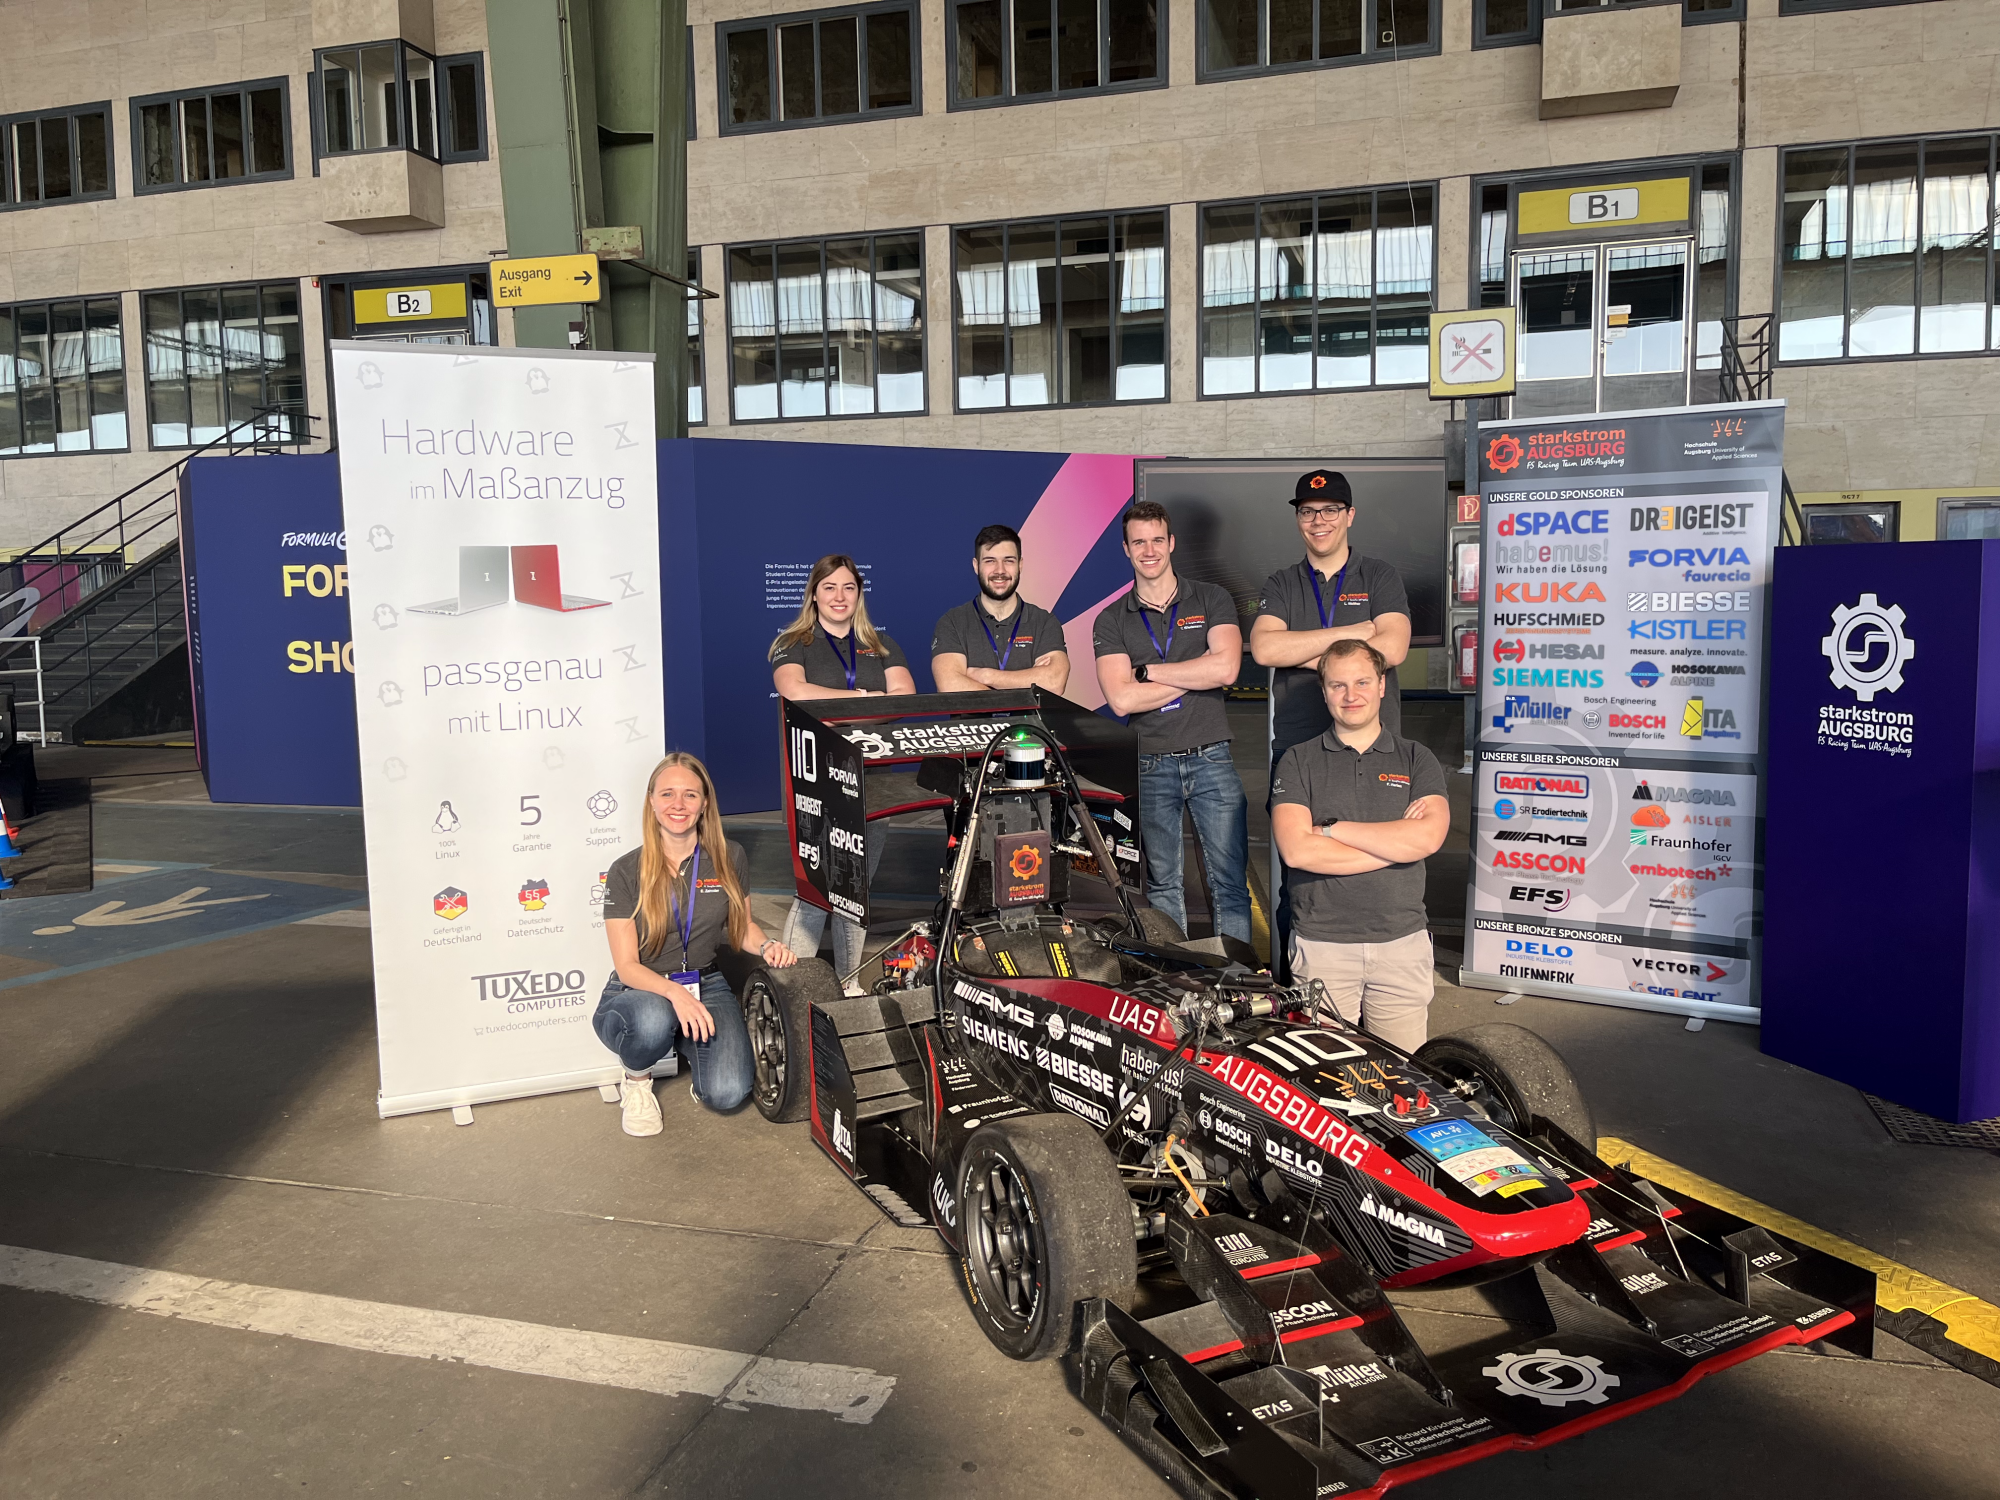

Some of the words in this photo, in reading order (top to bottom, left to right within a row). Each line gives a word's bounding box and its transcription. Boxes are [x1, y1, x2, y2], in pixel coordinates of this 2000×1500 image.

[1587, 194, 1620, 220] B1
[499, 267, 552, 282] Ausgang
[499, 286, 523, 299] Exit
[397, 294, 420, 314] B2
[381, 419, 574, 457] Hardware
[1528, 429, 1626, 445] starkstrom
[1684, 440, 1718, 448] Hochschule
[1526, 441, 1625, 460] AUGSBURG
[409, 480, 436, 500] im
[443, 466, 626, 509] Maßanzug
[1489, 492, 1527, 503] UNSERE
[1529, 490, 1558, 501] GOLD
[1560, 488, 1624, 500] SPONSOREN
[1497, 509, 1609, 537] dSPACE
[281, 531, 336, 548] FORMULA
[1495, 538, 1609, 564] habemus!
[1628, 547, 1751, 568] FORVIA
[1496, 565, 1513, 574] Wir
[1516, 564, 1548, 574] haben
[1551, 564, 1567, 573] die
[1570, 563, 1608, 574] Lösung
[1684, 569, 1751, 582] faurecia
[1494, 581, 1607, 603] KUKA
[1651, 591, 1751, 612] BIESSE
[1627, 619, 1747, 640] KISTLER
[1529, 643, 1605, 660] HESAI
[1630, 647, 1668, 656] measure.
[1669, 648, 1705, 658] analyze.
[423, 657, 602, 697] passgenau
[1492, 667, 1604, 688] SIEMENS
[1671, 664, 1746, 675] HOSOKAWA
[1670, 676, 1716, 687] ALPINE
[1512, 701, 1572, 720] Müller
[1583, 696, 1608, 705] Bosch
[1610, 697, 1657, 707] Engineering
[448, 710, 492, 735] mit
[498, 702, 583, 731] Linux
[1608, 713, 1666, 729] BOSCH
[1703, 709, 1737, 729] ITA
[1819, 704, 1914, 726] starkstrom
[891, 722, 1011, 740] starkstrom
[1608, 731, 1641, 739] Invented
[1641, 731, 1653, 739] for
[1653, 732, 1665, 740] life
[1817, 719, 1913, 743] AUGSBURG
[1481, 751, 1519, 762] UNSERE
[1520, 753, 1554, 764] SILBER
[1555, 755, 1619, 767] SPONSOREN
[828, 766, 859, 787] FORVIA
[1499, 776, 1585, 794] RATIONAL
[1655, 786, 1736, 807] MAGNA
[519, 794, 543, 826] 5
[1519, 806, 1530, 815] SR
[1531, 807, 1588, 819] Erodiertechnik
[589, 826, 617, 834] Lifetime
[1682, 814, 1732, 828] AISLER
[438, 839, 457, 848] 100%
[523, 832, 541, 840] Jahre
[585, 835, 621, 847] Support
[829, 826, 865, 857] dSPACE
[1651, 835, 1732, 852] Fraunhofer
[435, 850, 461, 860] Linux
[512, 841, 552, 853] Garantie
[1492, 850, 1586, 875] ASSCON
[1713, 854, 1732, 862] IGCV
[1508, 885, 1564, 905] EFS
[433, 926, 463, 936] Gefertigt
[464, 924, 472, 932] in
[518, 916, 553, 926] Deutscher
[423, 932, 483, 948] Deutschland
[507, 924, 565, 938] Datenschutz
[1476, 919, 1514, 932] UNSERE
[1516, 926, 1557, 937] BRONZE
[1558, 929, 1623, 944] SPONSOREN
[1505, 939, 1574, 958] DELO
[1505, 952, 1535, 962] INDUSTRIE
[1535, 957, 1573, 966] KLEBSTOFFE
[1631, 957, 1701, 976] VECTOR
[470, 969, 586, 1003] TUXEDO
[507, 995, 586, 1014] COMPUTERS
[485, 1014, 588, 1034] tuxedocomputers.com
[1108, 995, 1159, 1036] UAS
[961, 1015, 1030, 1061] SIEMENS
[1069, 1033, 1095, 1053] ALPINE
[1070, 1022, 1112, 1048] HOSOKAWA
[1050, 1051, 1115, 1099] BIESSE
[1052, 1089, 1110, 1127] RATIONAL
[1212, 1055, 1370, 1167] AUGSBURG
[1216, 1099, 1246, 1122] Engineering
[1215, 1117, 1252, 1148] BOSCH
[1430, 1129, 1451, 1139] AVL
[1265, 1138, 1324, 1177] DELO
[932, 1171, 956, 1228] KUK
[1378, 1204, 1447, 1248] MAGNA
[1272, 1300, 1334, 1323] SSCON
[1349, 1373, 1388, 1389] AHLHORN
[1251, 1399, 1294, 1420] ETAS
